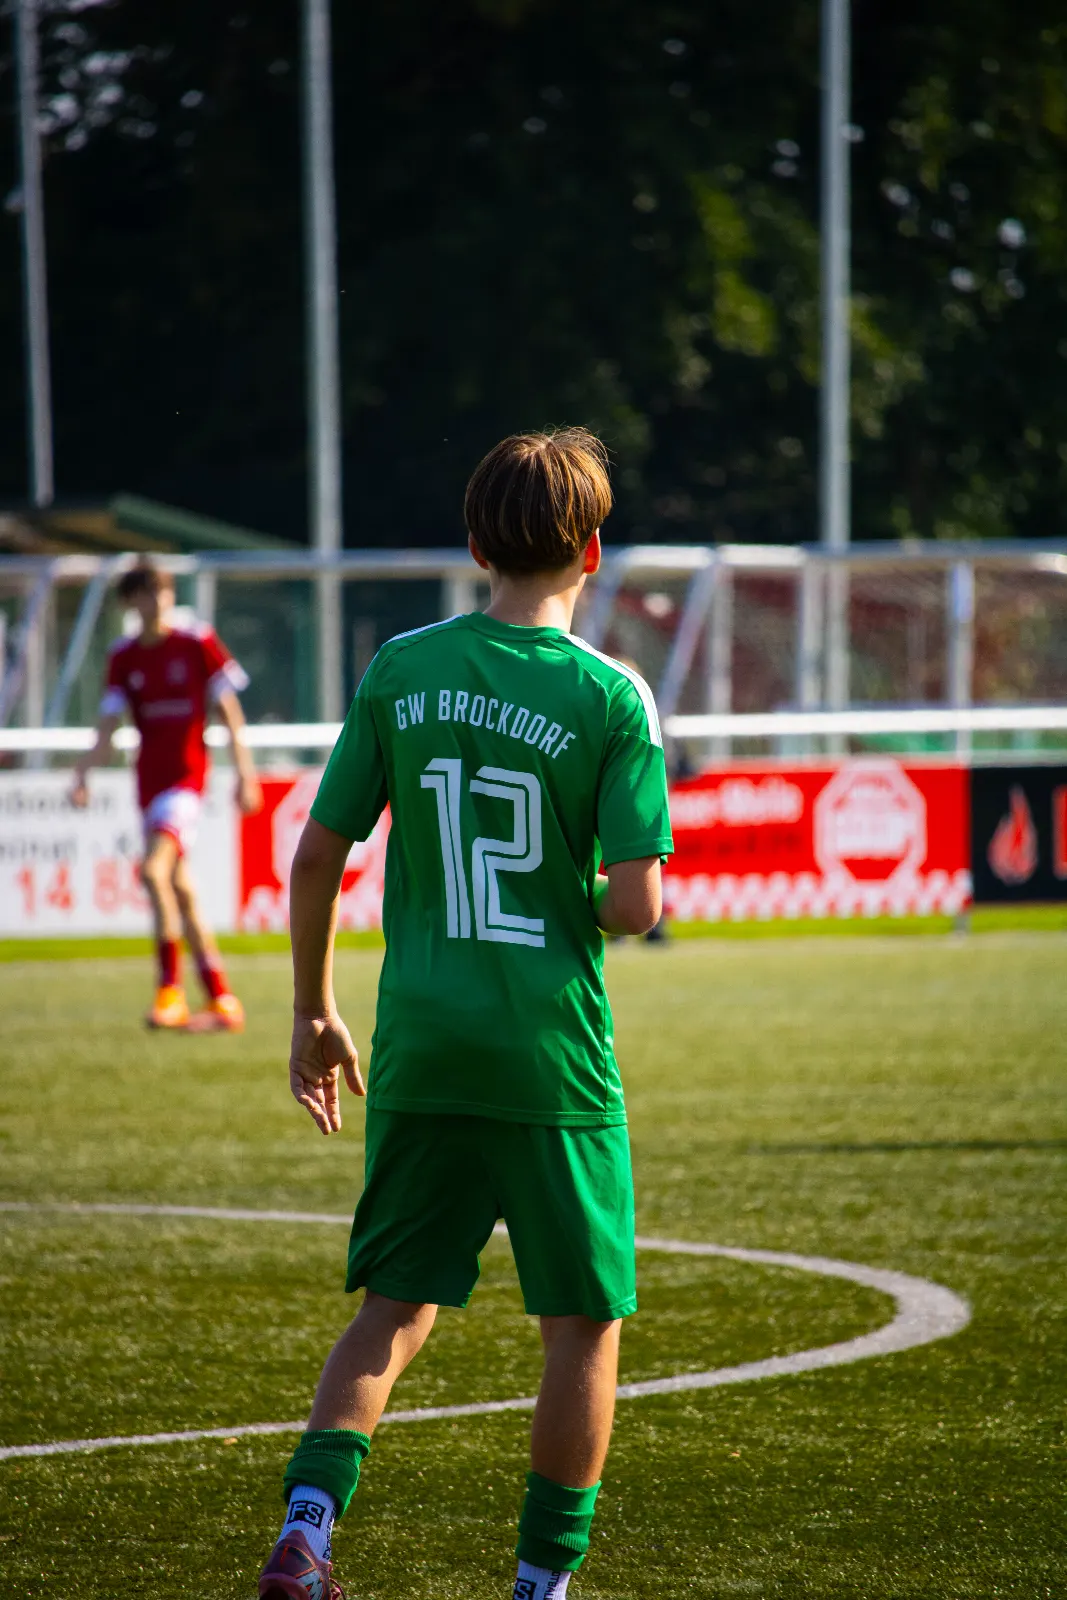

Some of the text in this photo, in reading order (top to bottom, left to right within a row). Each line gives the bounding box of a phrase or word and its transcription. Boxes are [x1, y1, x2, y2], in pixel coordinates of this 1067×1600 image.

[394, 689, 577, 759] GW BROCKDORF
[419, 757, 546, 948] 12
[289, 1501, 323, 1526] FS
